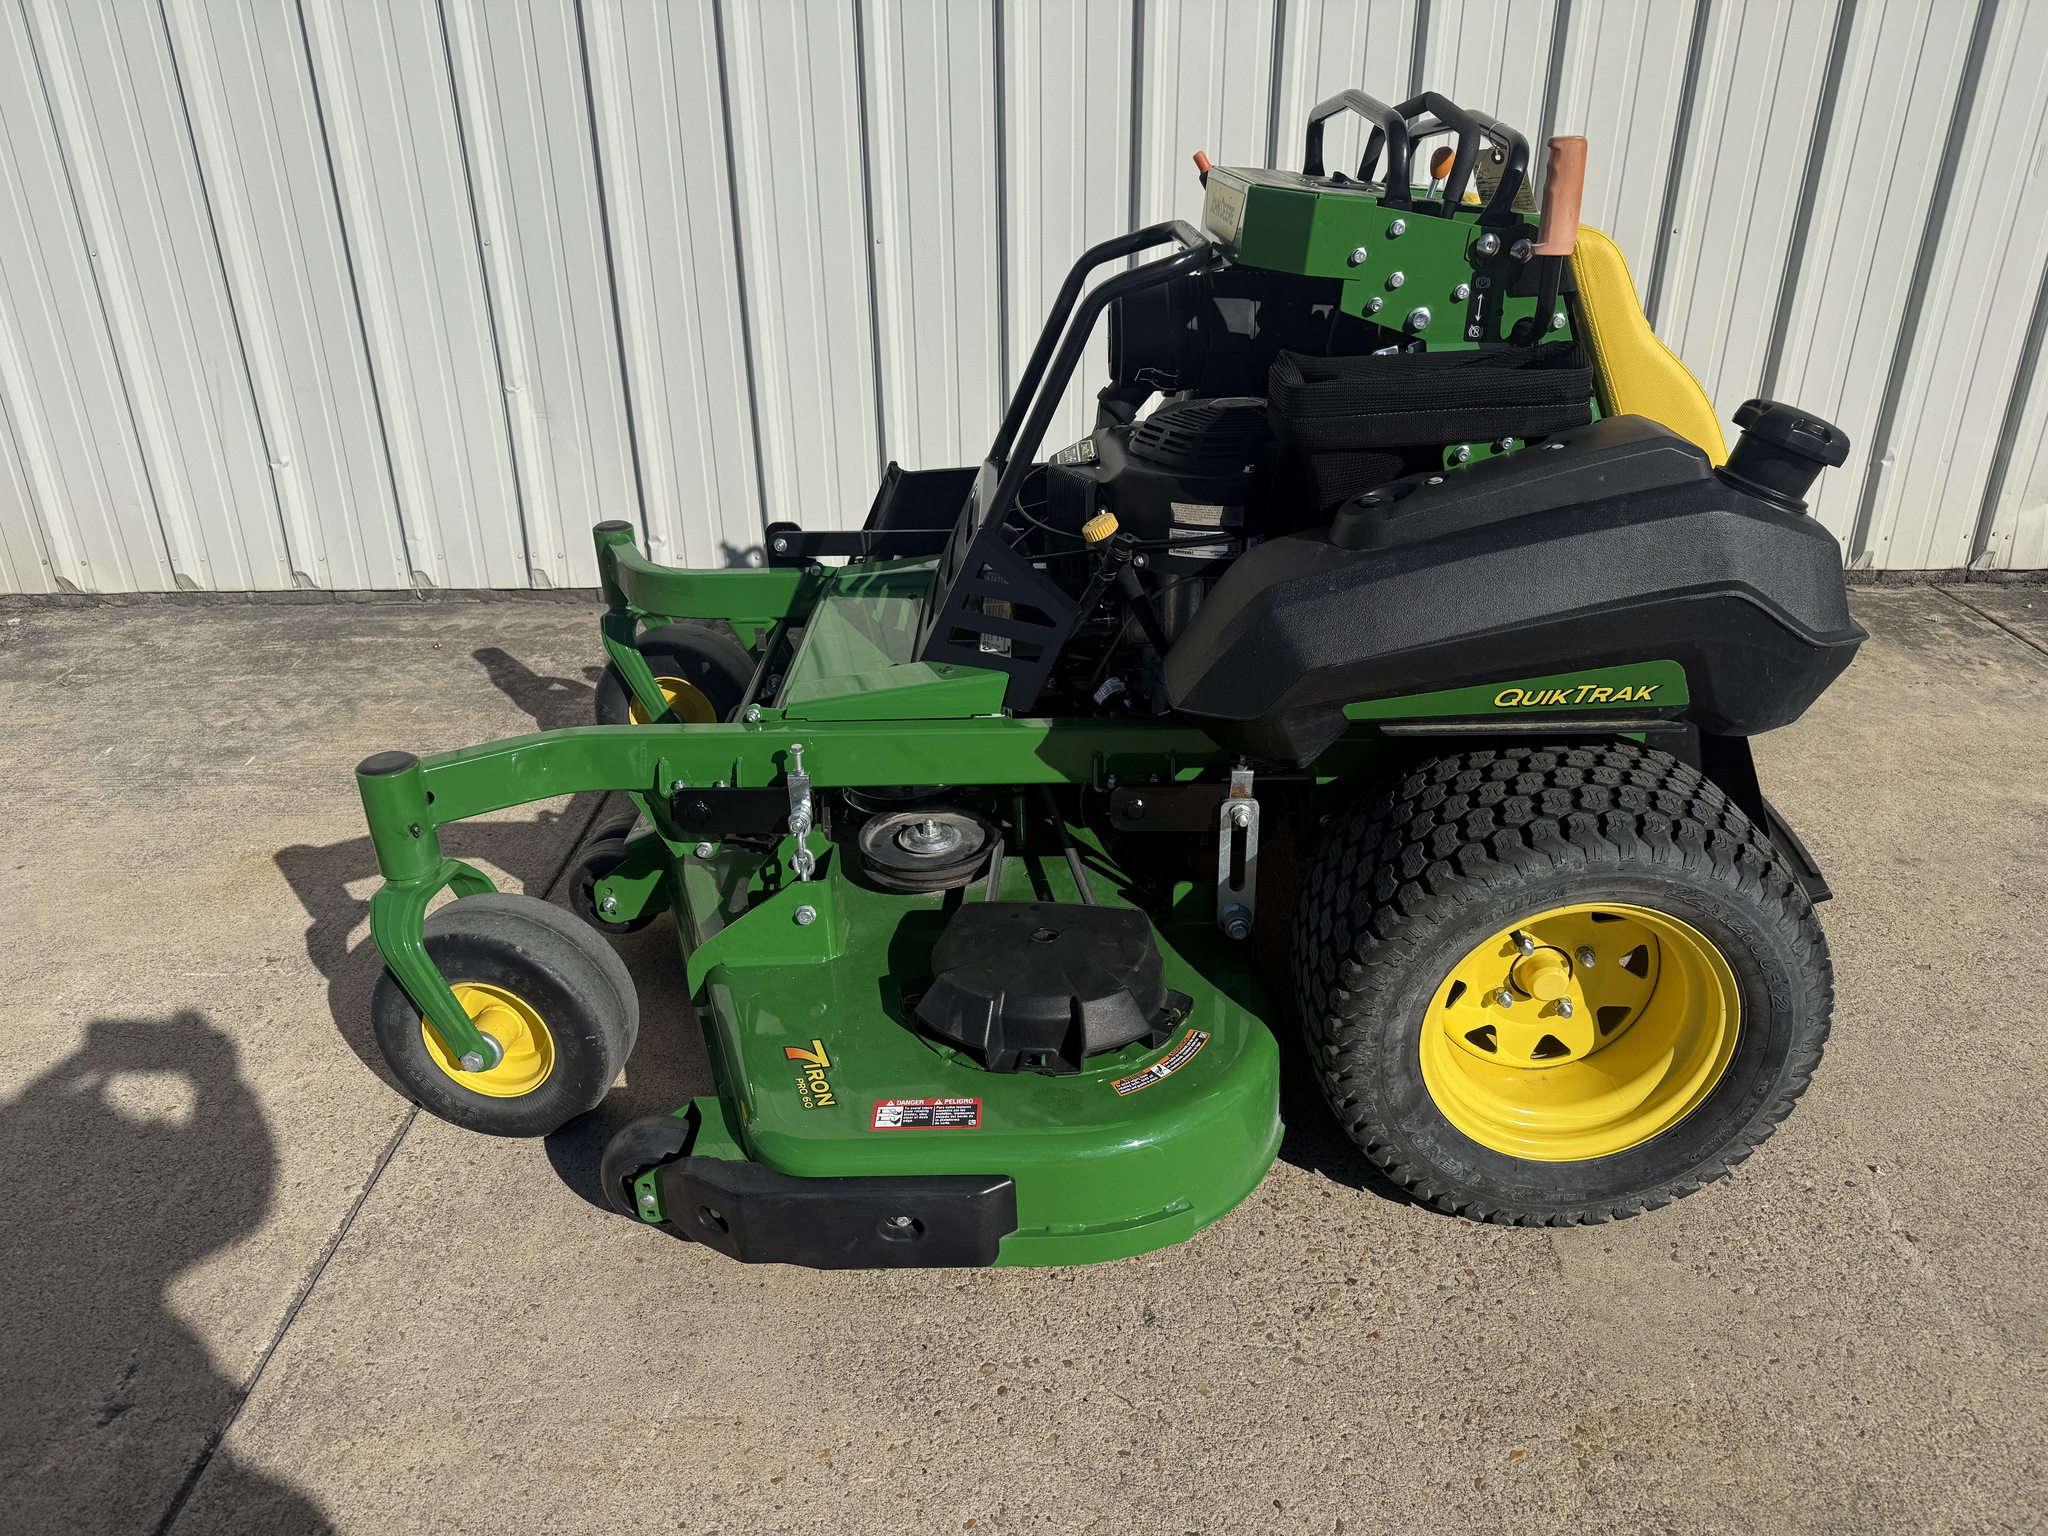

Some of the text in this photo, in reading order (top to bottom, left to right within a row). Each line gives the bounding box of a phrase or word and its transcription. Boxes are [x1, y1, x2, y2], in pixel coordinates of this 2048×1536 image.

[1220, 197, 1235, 225] DEERE
[1397, 883, 1577, 1014] SUPER TURF
[396, 1049, 480, 1120] CARLSTAR
[794, 1077, 814, 1109] PRO 60
[1399, 1113, 1482, 1186] KENDA
